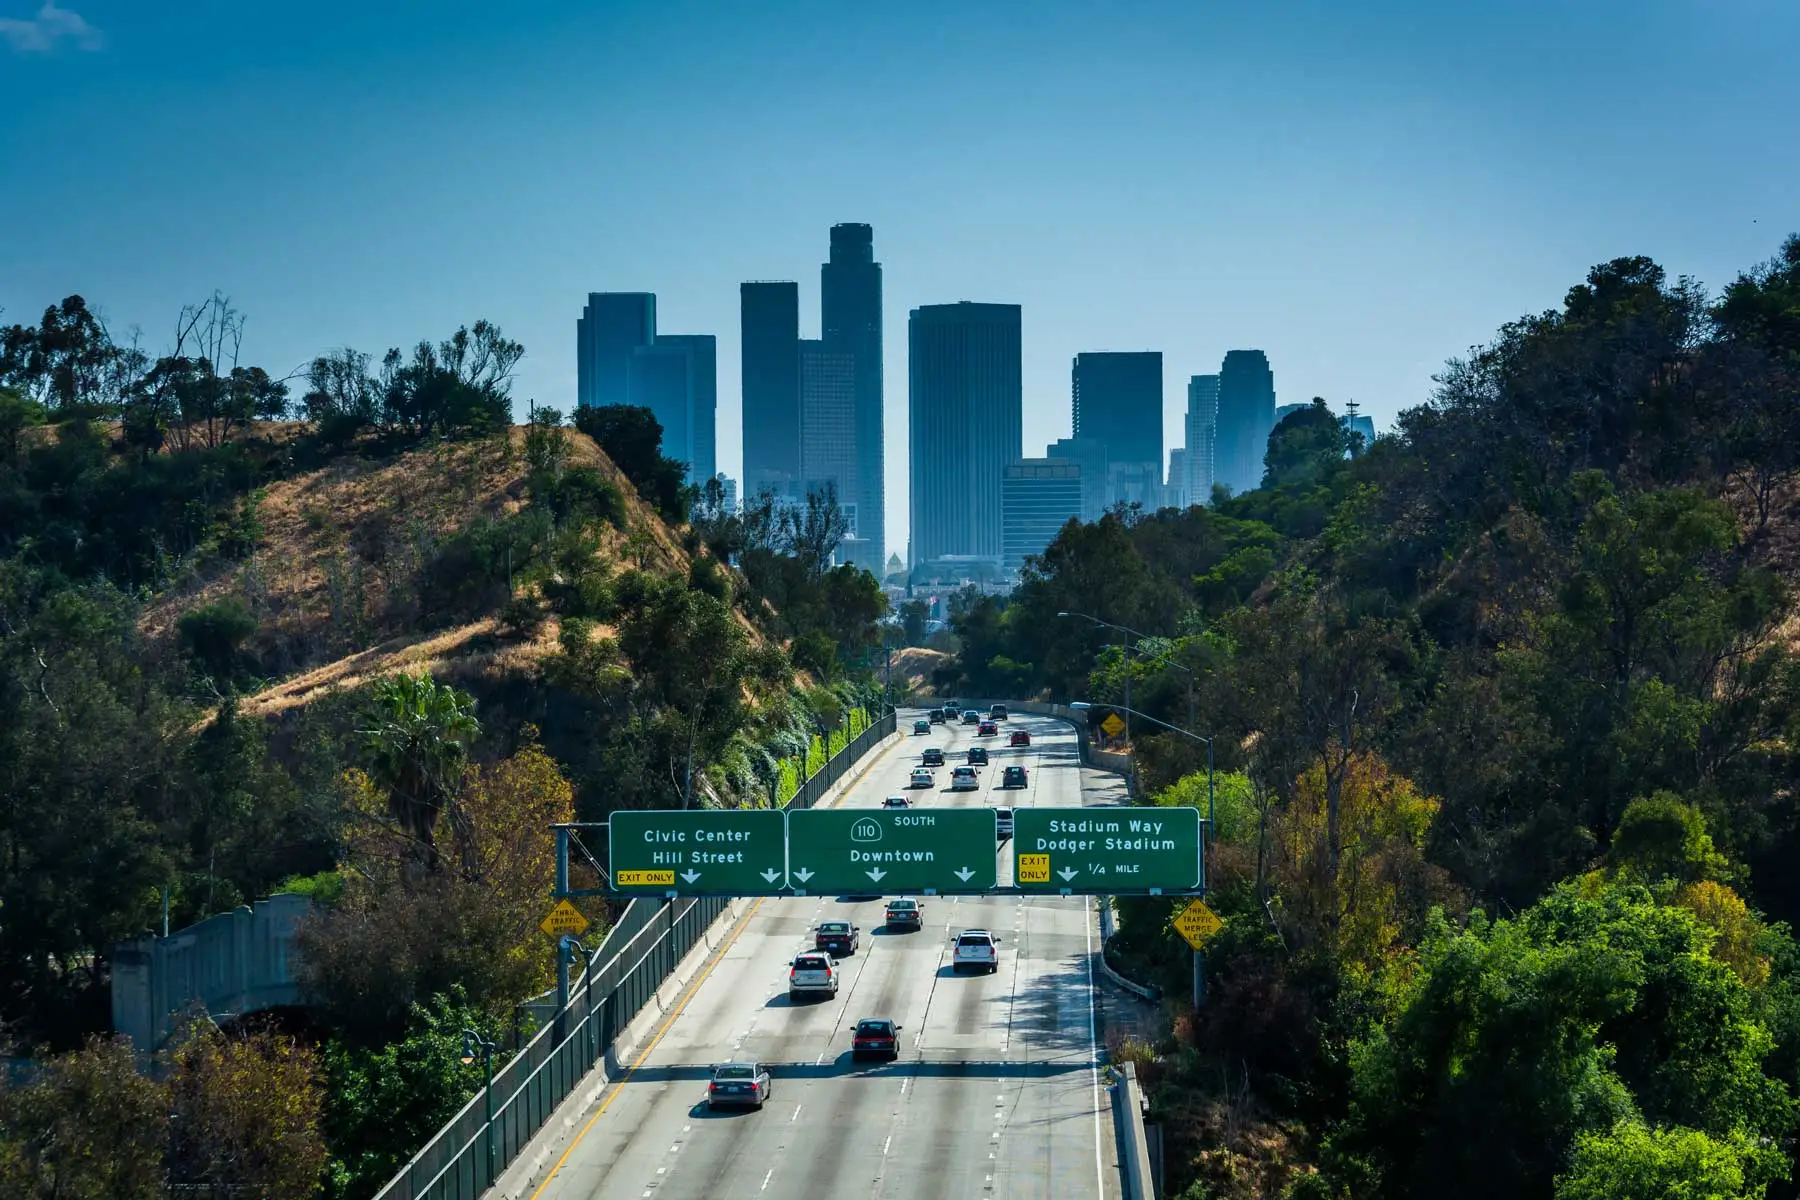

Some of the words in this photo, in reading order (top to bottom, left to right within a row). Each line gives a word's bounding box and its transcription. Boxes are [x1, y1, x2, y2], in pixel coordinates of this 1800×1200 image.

[894, 816, 935, 826] SOUTH
[857, 825, 875, 837] 110
[1049, 820, 1119, 833] Stadium
[1129, 820, 1163, 835] Way
[644, 830, 686, 842] Civic
[695, 829, 751, 842] Center
[1037, 838, 1096, 853] Dodger
[1105, 838, 1175, 850] Stadium
[653, 851, 682, 864] Hill
[691, 851, 743, 863] Street
[850, 849, 934, 862] Downtown
[1021, 857, 1047, 865] EXIT
[1021, 871, 1047, 879] ONLY
[1115, 865, 1140, 873] MILE
[619, 873, 641, 882] EXIT
[646, 873, 672, 882] ONLY
